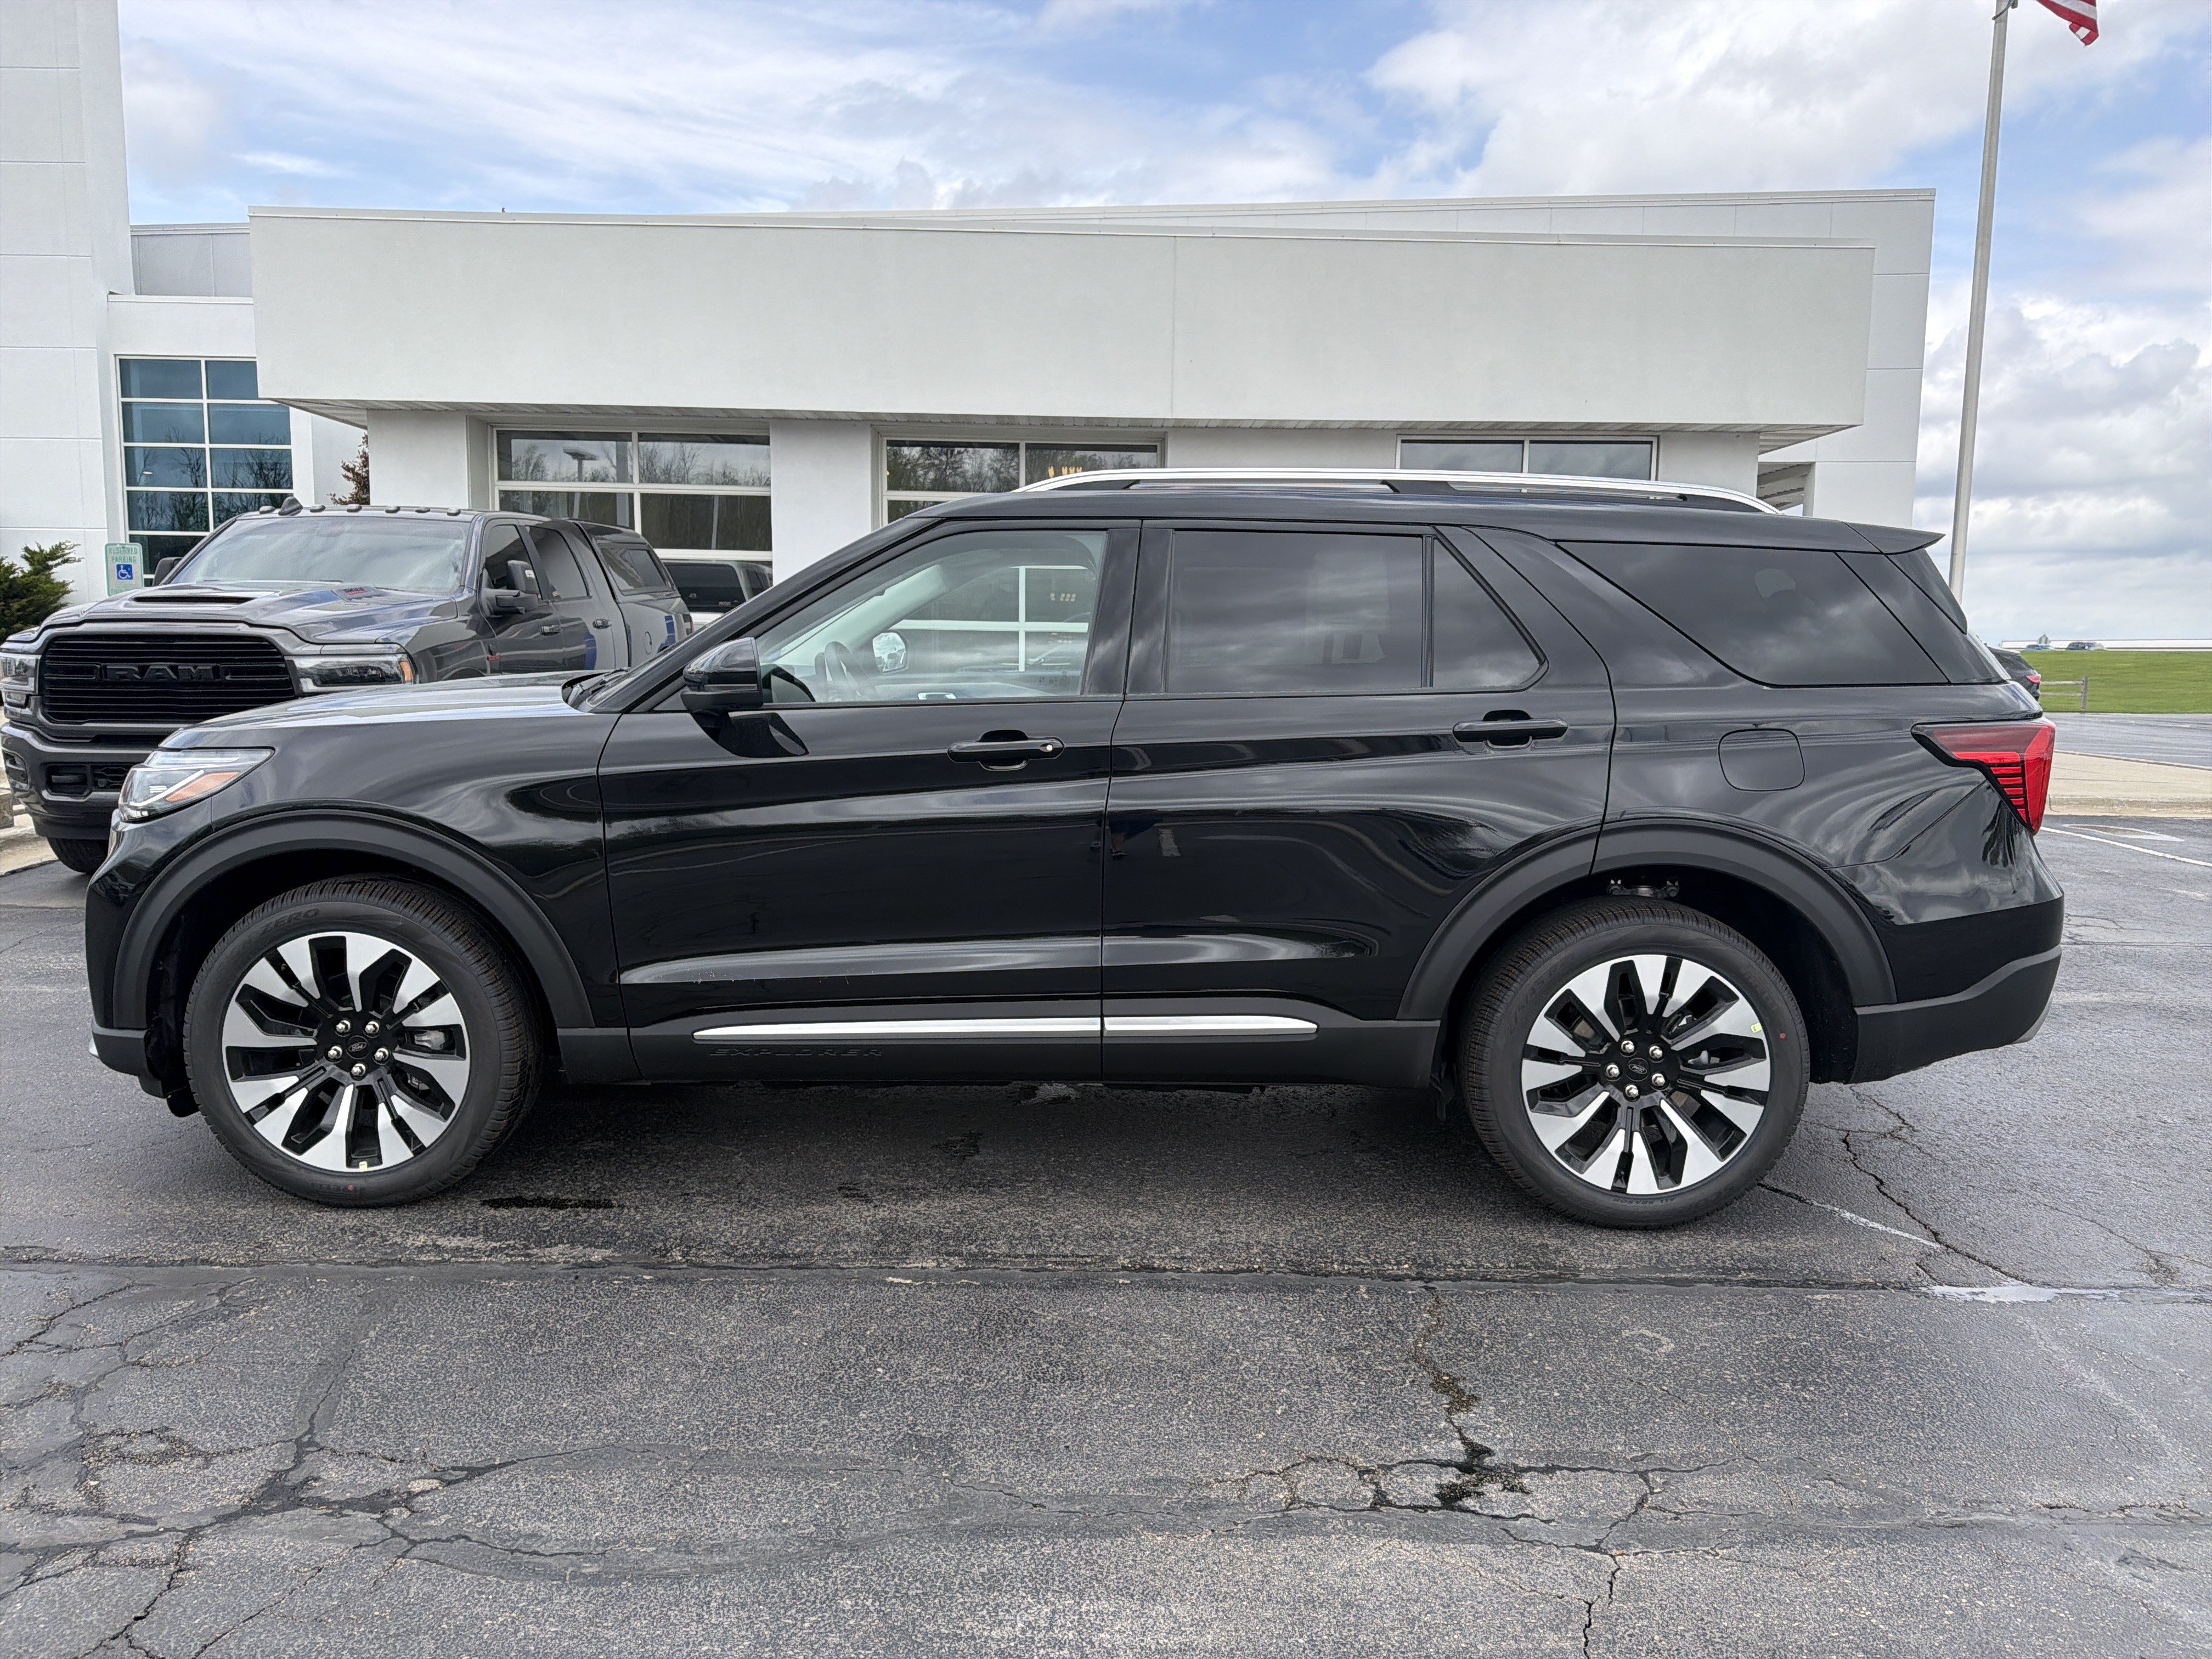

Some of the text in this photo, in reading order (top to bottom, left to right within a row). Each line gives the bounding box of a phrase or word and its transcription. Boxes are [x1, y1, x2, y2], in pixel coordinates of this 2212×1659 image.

[109, 546, 138, 555] RESERVED
[105, 663, 215, 681] RAM
[263, 908, 320, 933] ZERO
[709, 1048, 882, 1057] EXPLORER
